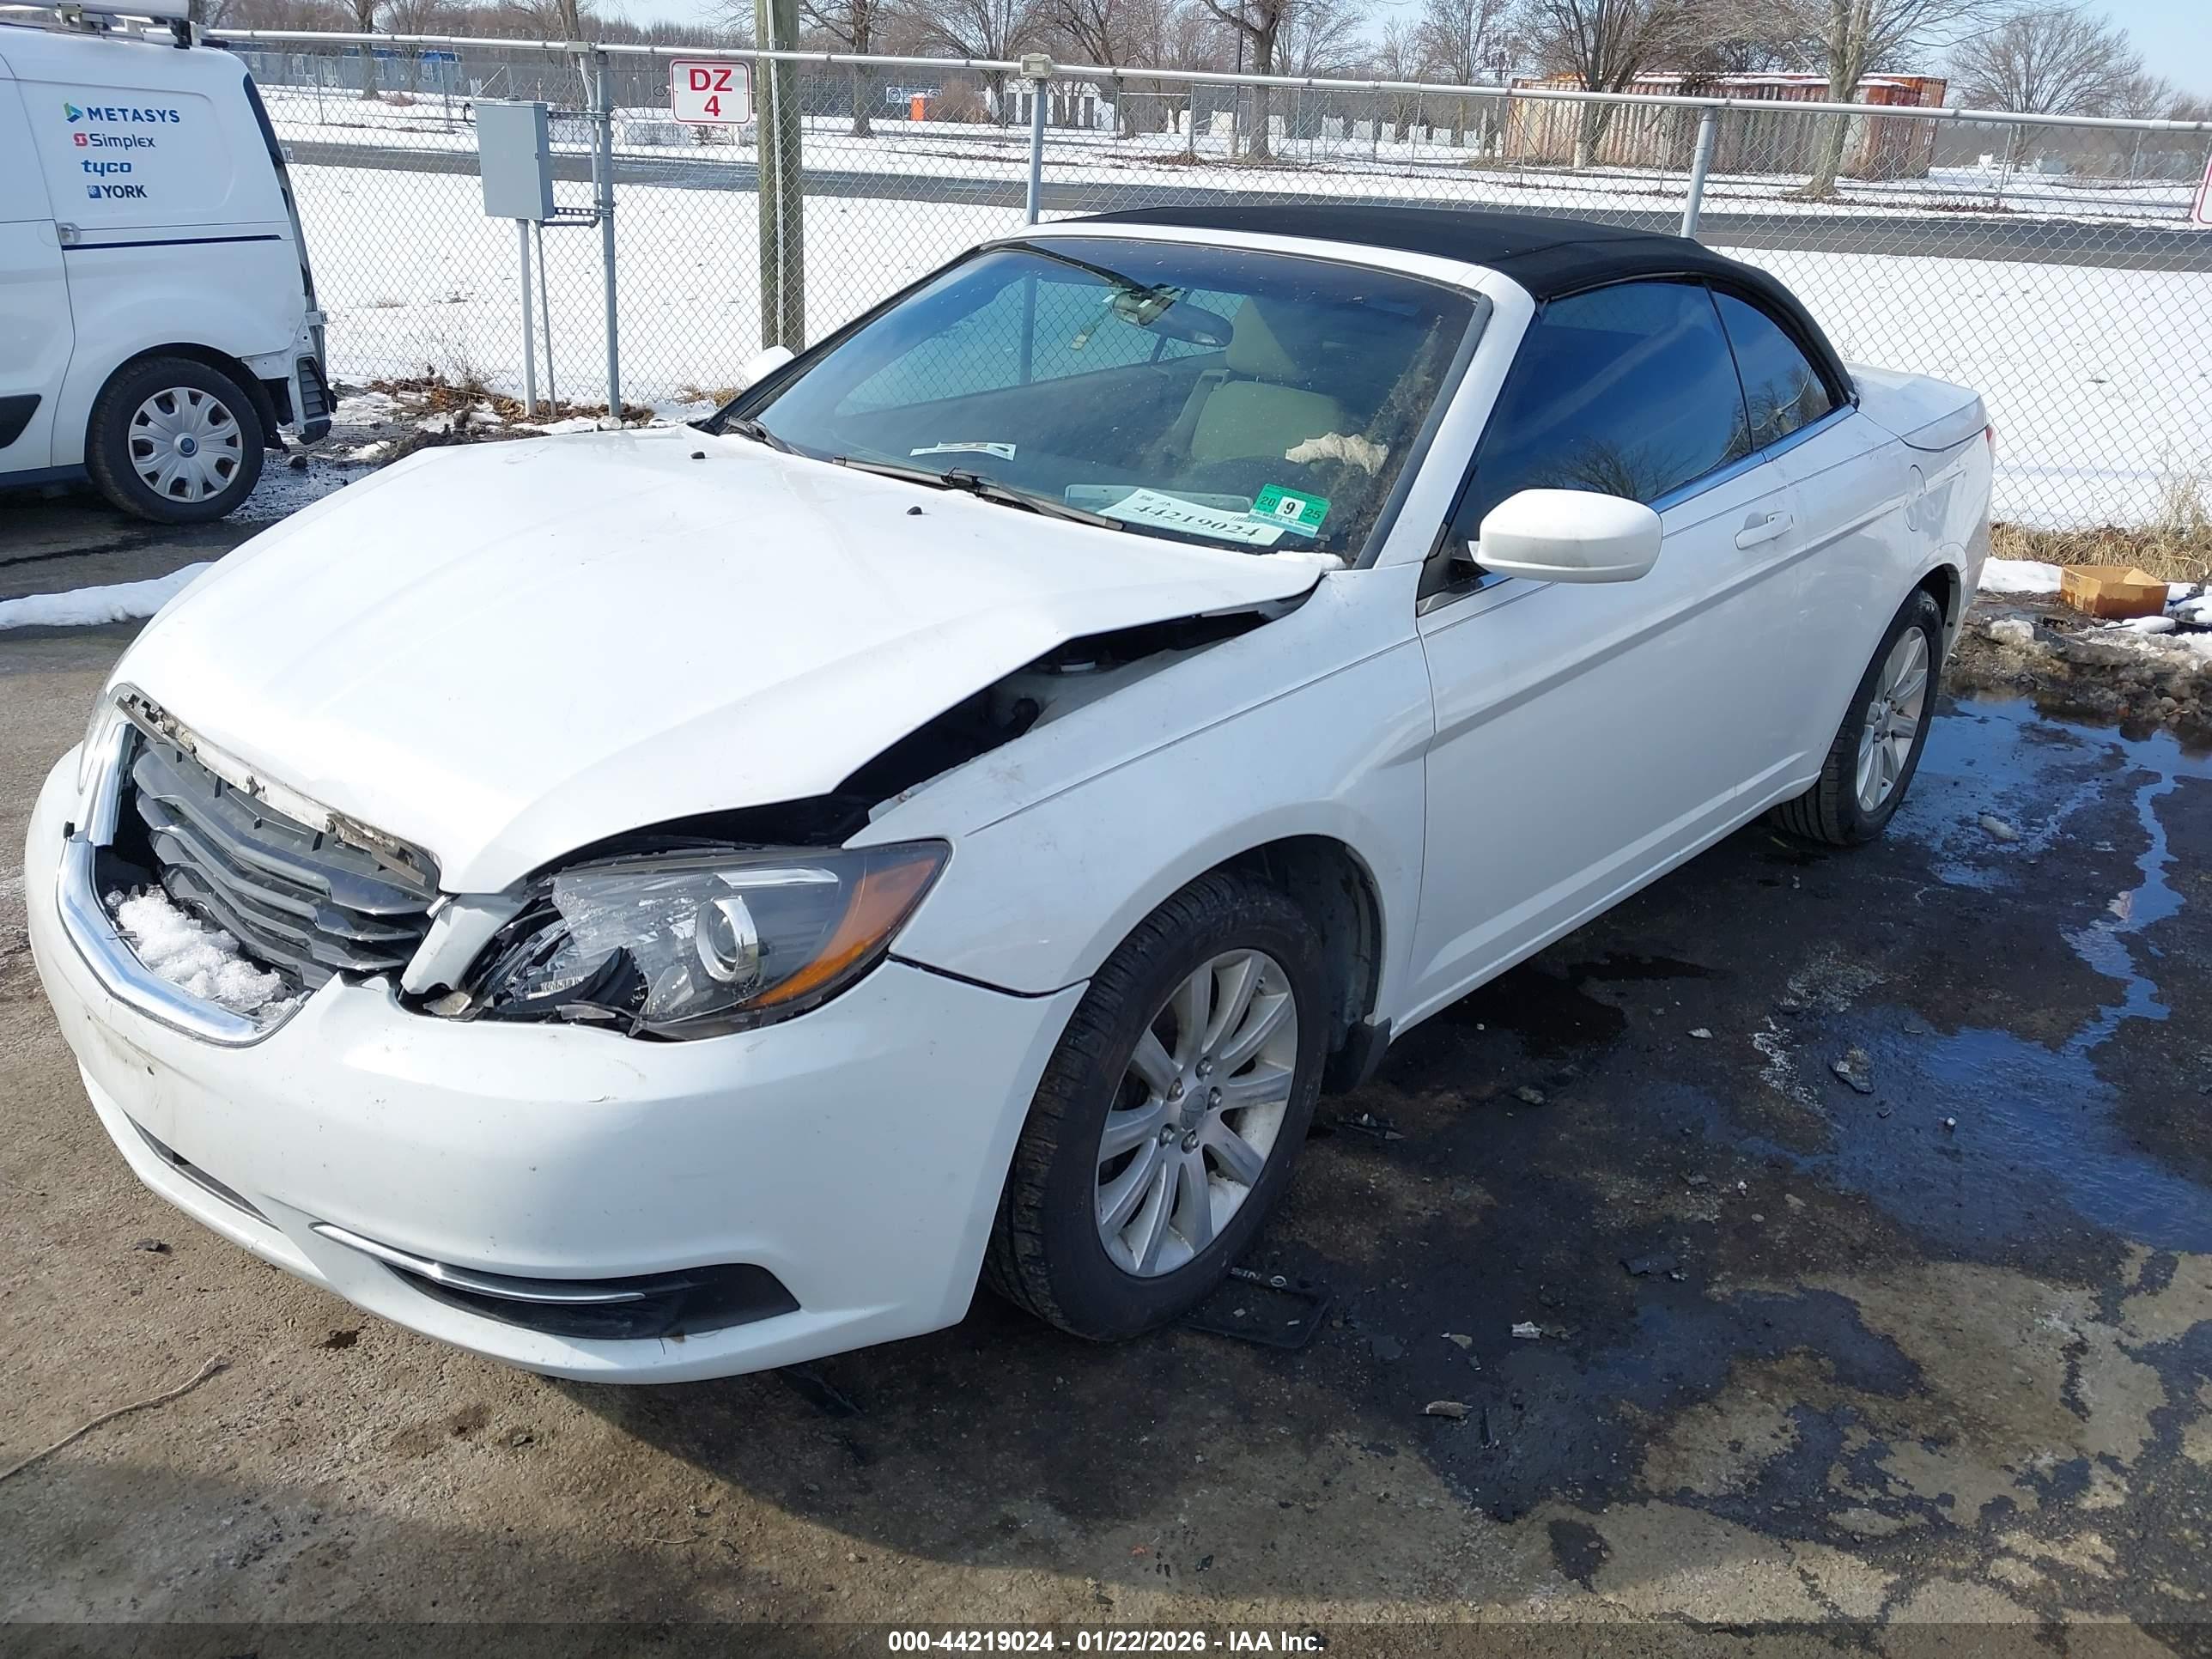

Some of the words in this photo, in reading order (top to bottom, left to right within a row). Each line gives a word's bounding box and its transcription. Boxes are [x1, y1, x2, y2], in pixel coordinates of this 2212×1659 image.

[690, 68, 732, 92] DZ
[87, 106, 180, 123] METASYS
[704, 95, 720, 117] 4
[89, 133, 155, 150] Simplex
[82, 160, 131, 177] tyco
[101, 185, 148, 198] YORK
[1260, 496, 1276, 507] 20
[1284, 501, 1296, 514] 9
[1304, 508, 1322, 520] 25
[1133, 506, 1261, 537] 44219024
